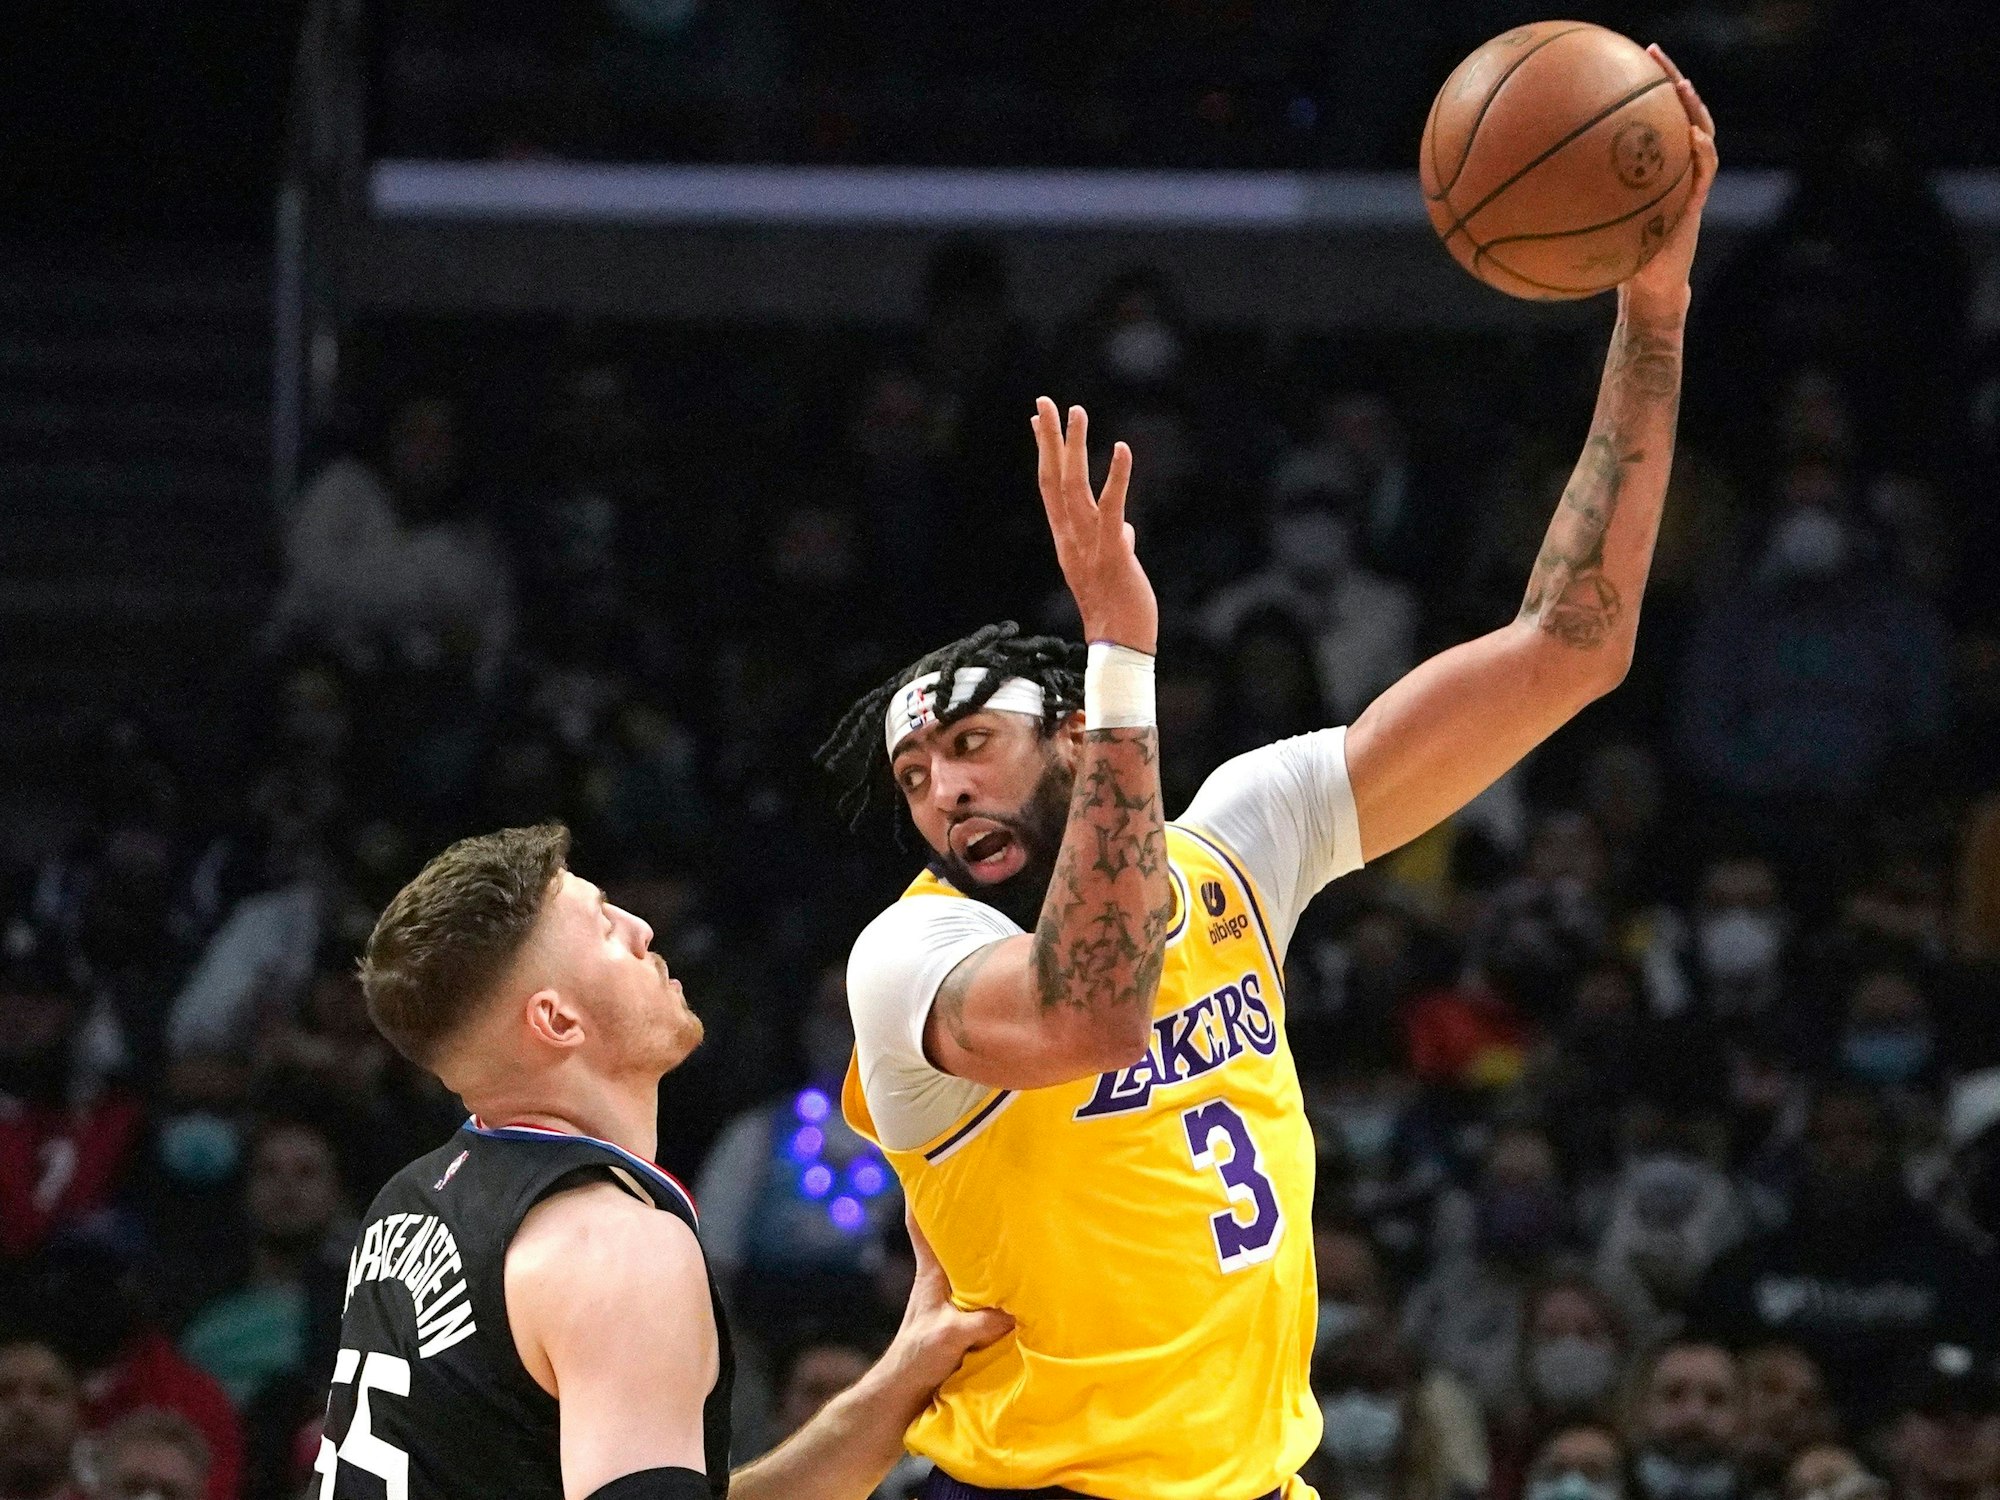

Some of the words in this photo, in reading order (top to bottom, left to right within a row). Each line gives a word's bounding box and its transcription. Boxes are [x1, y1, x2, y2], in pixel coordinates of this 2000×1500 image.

[1208, 914, 1248, 945] bibigo
[1075, 972, 1277, 1119] LAKERS
[1183, 1100, 1283, 1273] 3
[341, 1213, 477, 1359] ARTENSTEIN
